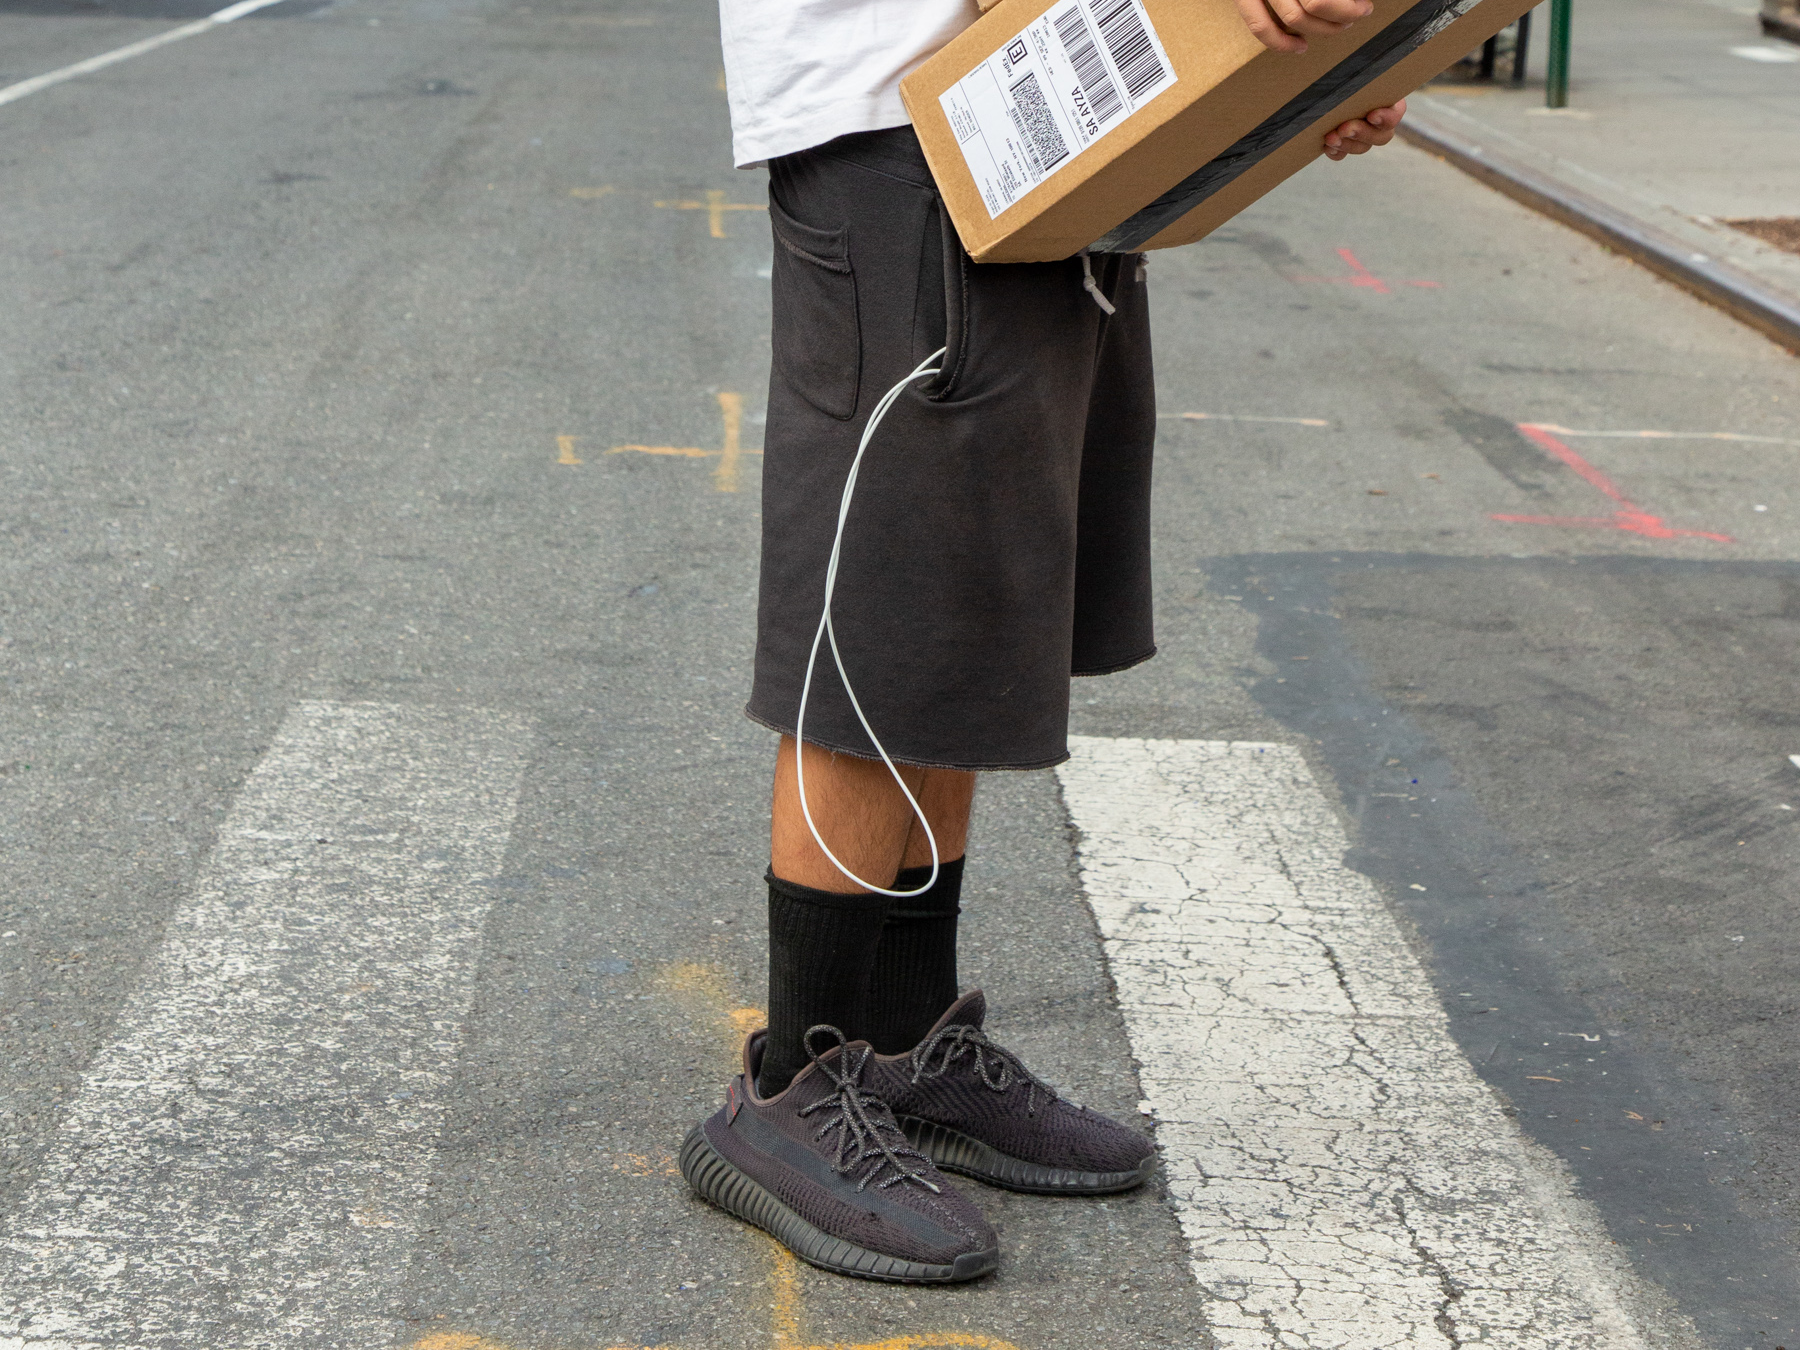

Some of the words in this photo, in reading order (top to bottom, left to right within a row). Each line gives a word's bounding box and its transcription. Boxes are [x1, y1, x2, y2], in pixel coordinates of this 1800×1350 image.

[1010, 45, 1023, 59] E
[1000, 56, 1014, 78] FedEx
[1069, 84, 1091, 119] AYZA
[1083, 116, 1099, 137] SA
